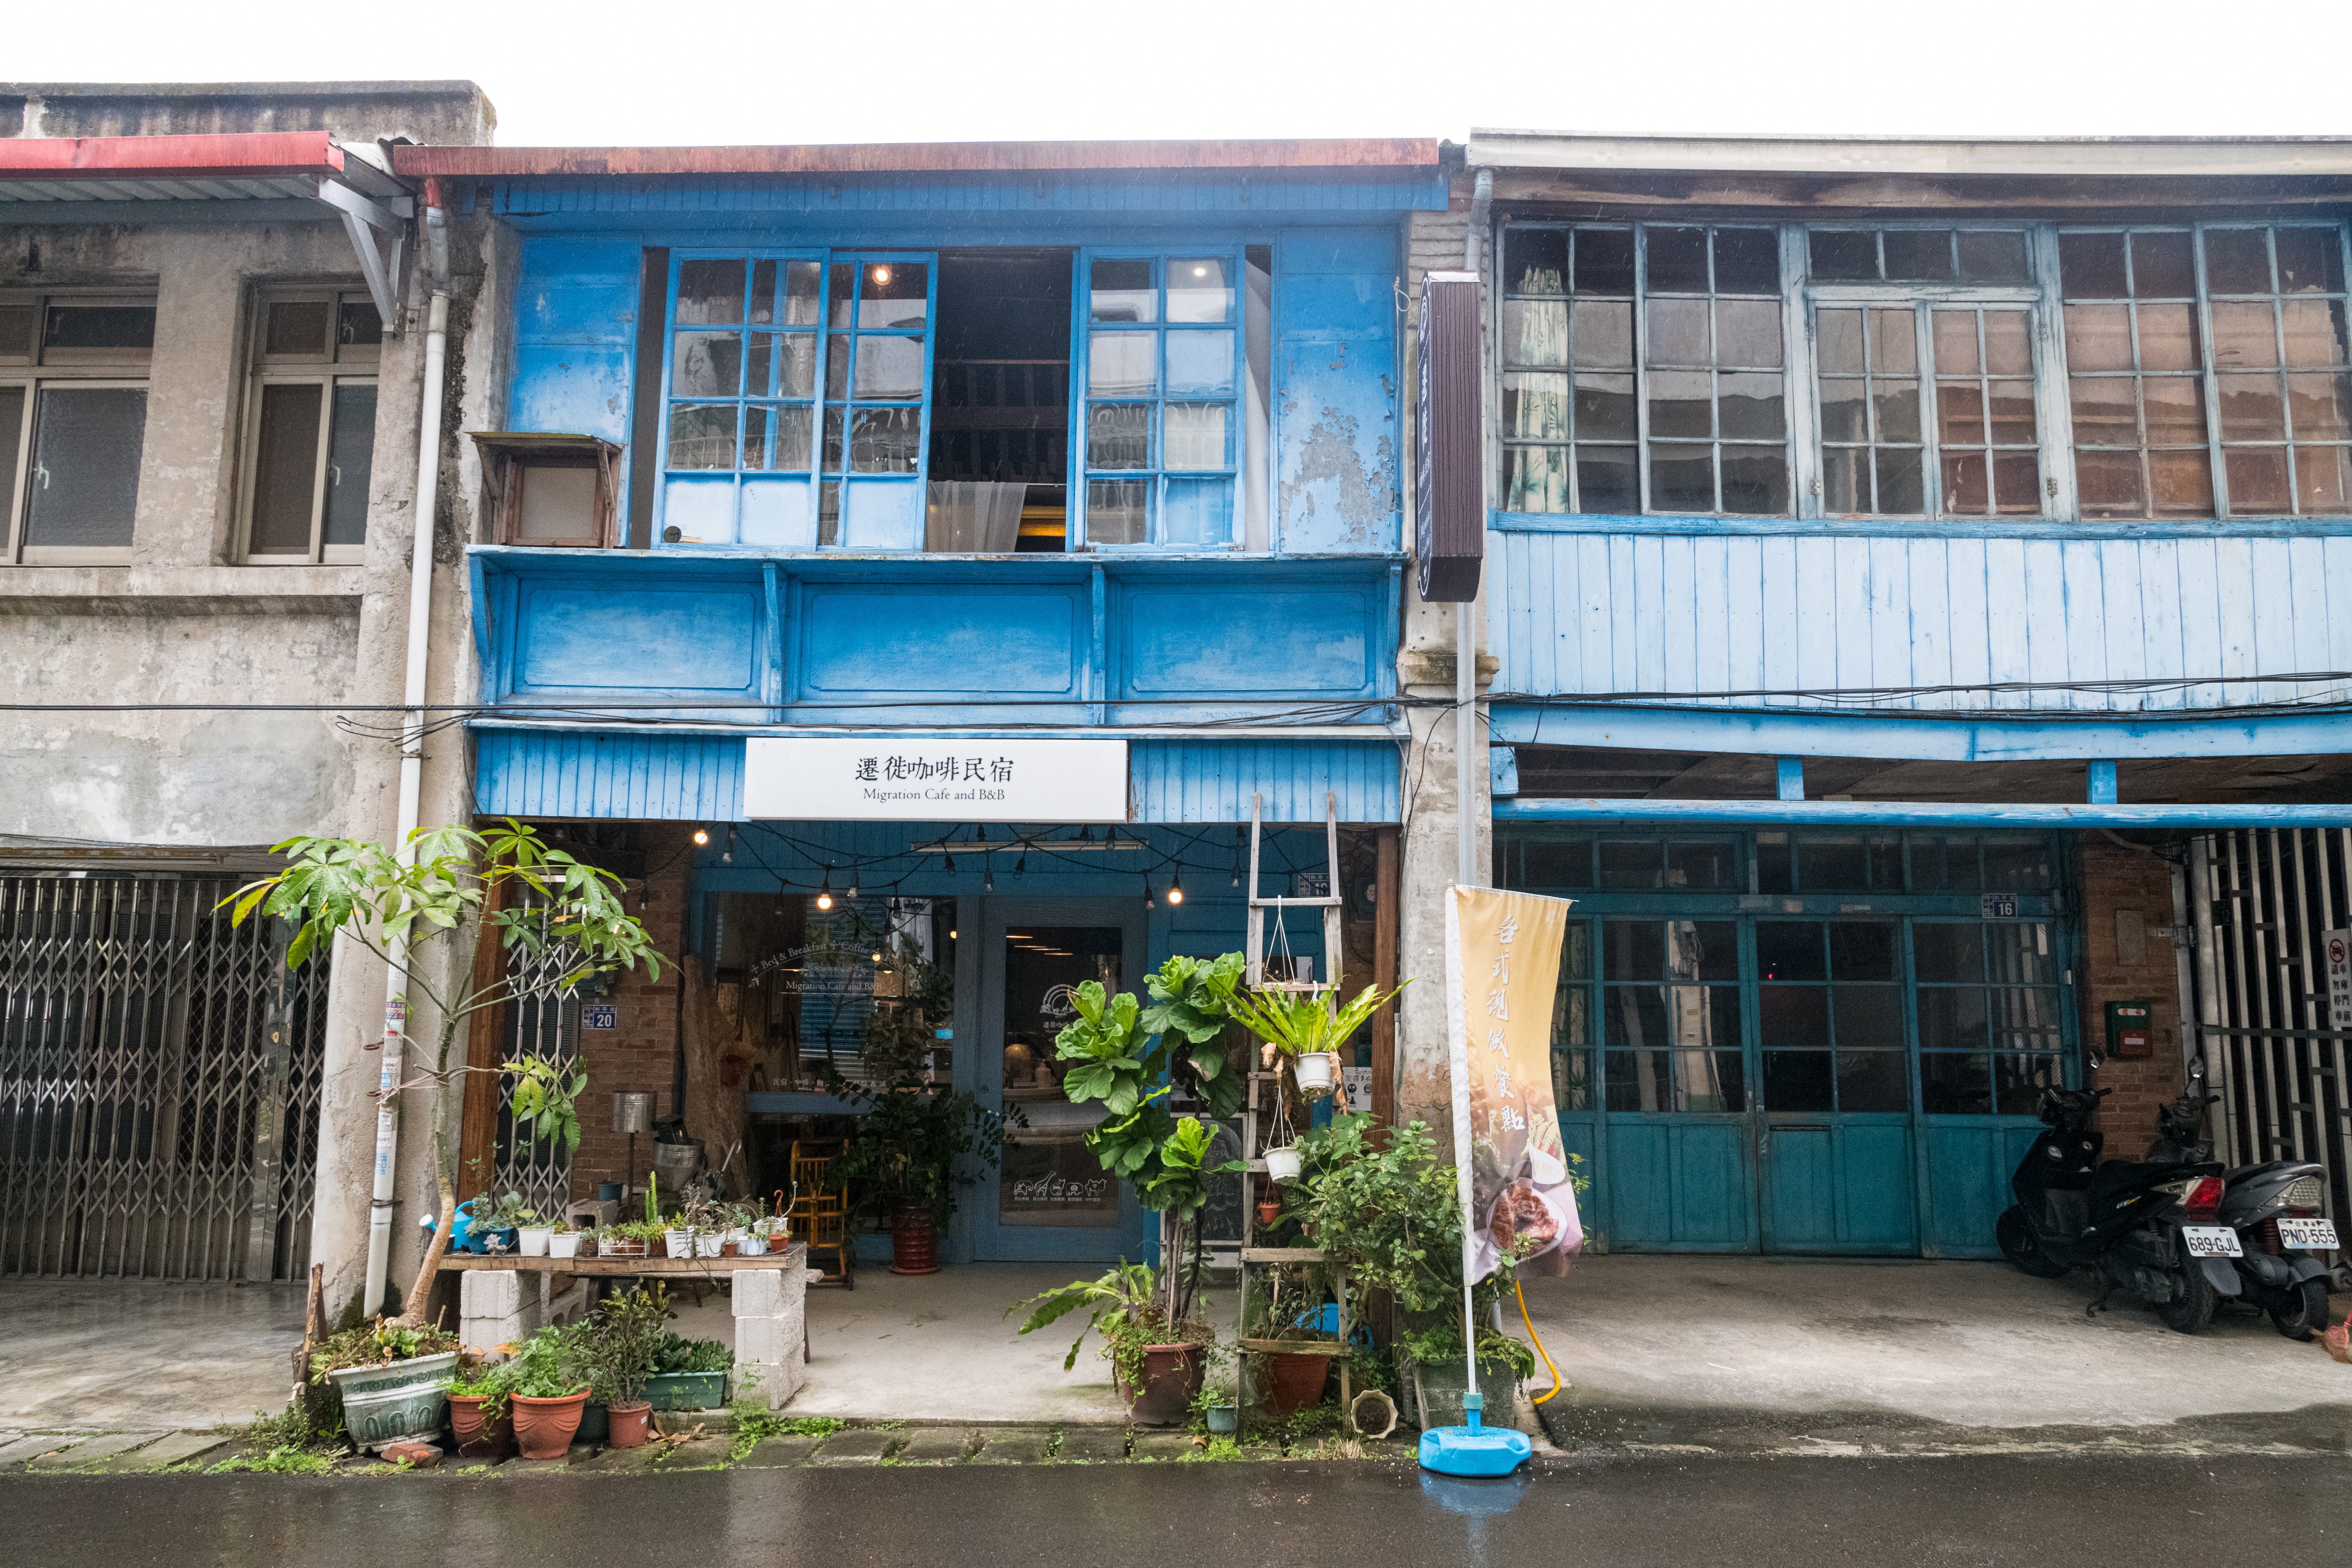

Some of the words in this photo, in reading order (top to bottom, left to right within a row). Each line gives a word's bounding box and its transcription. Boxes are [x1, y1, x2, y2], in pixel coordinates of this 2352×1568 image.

[855, 756, 1014, 783] 遷徙咖啡民宿
[863, 788, 921, 803] Migration
[925, 788, 950, 800] Cafe
[954, 789, 975, 800] and
[979, 789, 1005, 800] B&B
[1998, 902, 2012, 915] 16
[761, 955, 778, 970] Bed
[779, 952, 787, 961] &
[787, 942, 827, 957] Breakfast
[841, 941, 869, 954] Coffee
[884, 954, 907, 972] Food
[786, 980, 825, 992] Migration
[848, 981, 861, 990] and
[597, 1014, 612, 1027] 20
[1486, 913, 1526, 1132] 各式現做餐點
